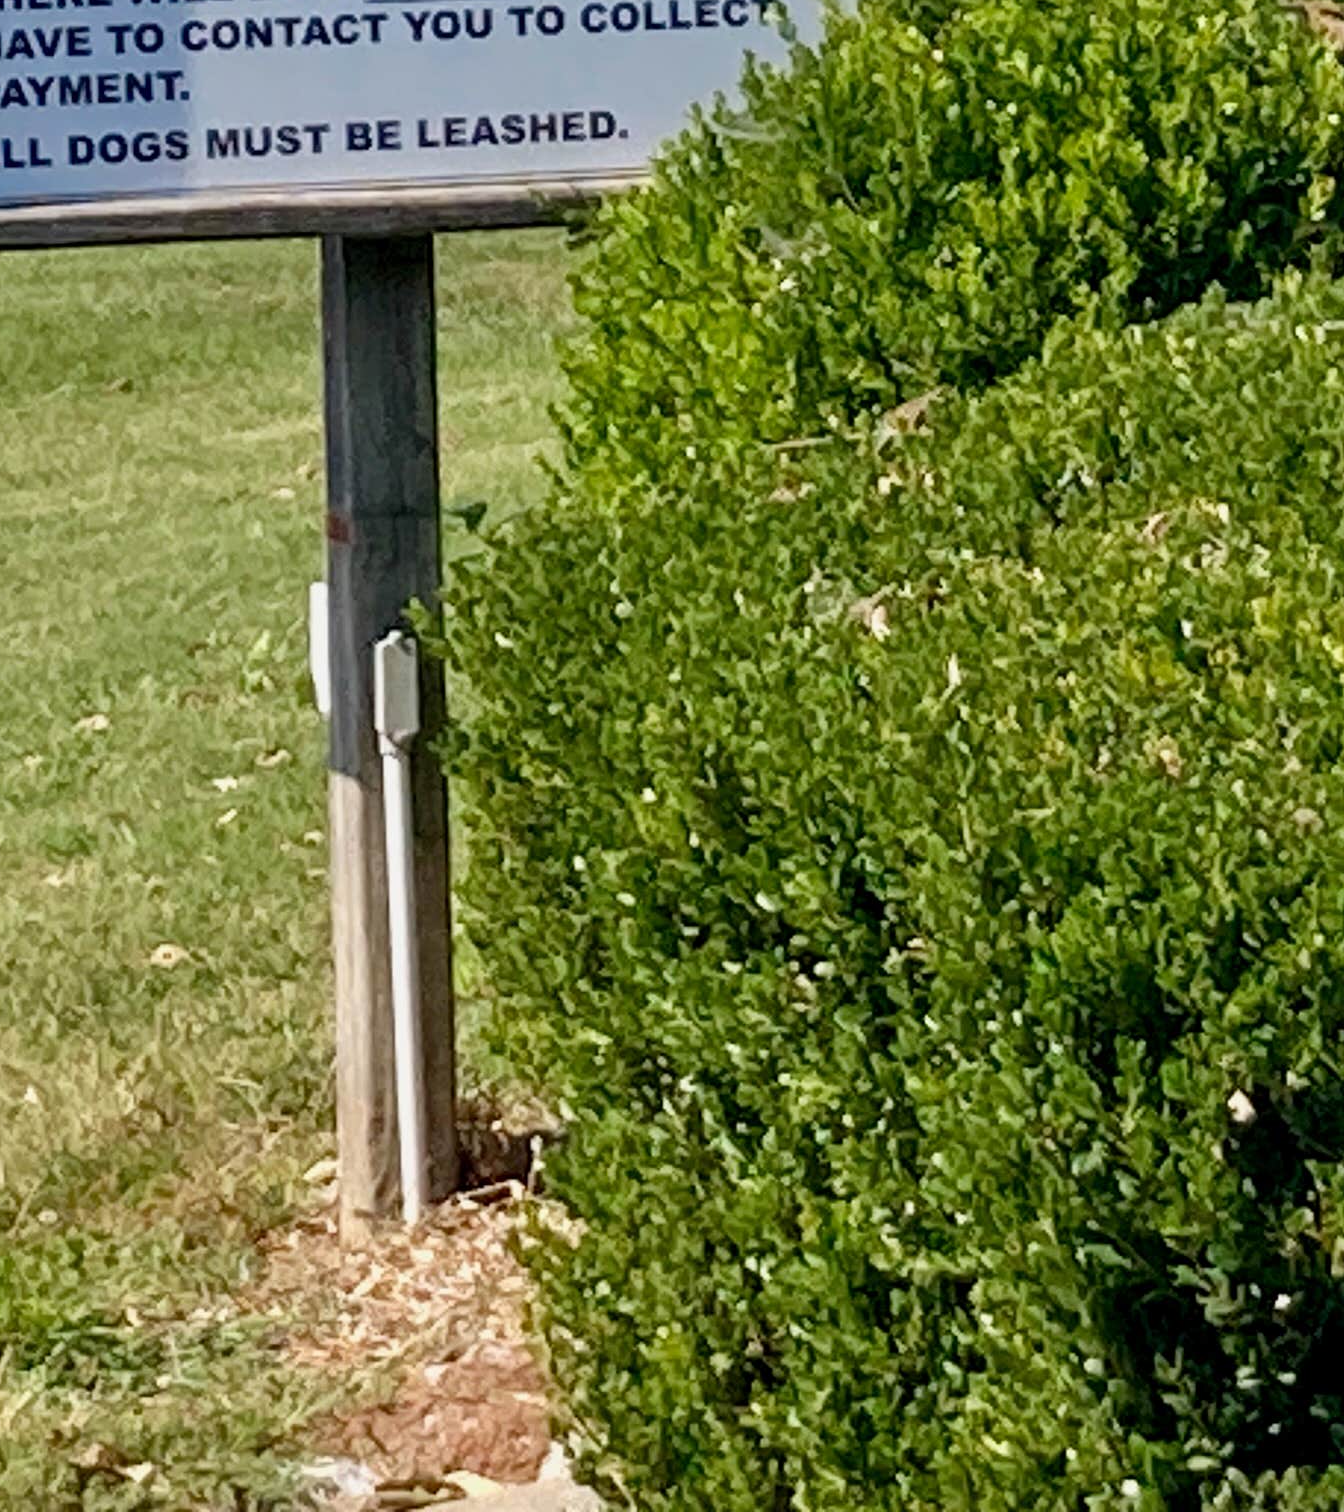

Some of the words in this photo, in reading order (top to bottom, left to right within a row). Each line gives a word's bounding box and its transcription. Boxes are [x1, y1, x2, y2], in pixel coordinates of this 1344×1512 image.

[105, 22, 165, 55] TO
[179, 14, 389, 52] CONTACT
[402, 8, 493, 43] YOU
[507, 4, 565, 37] TO
[68, 128, 190, 166] DOGS
[206, 122, 330, 159] MUST
[345, 119, 402, 152] BE
[417, 111, 629, 148] LEASHED.
